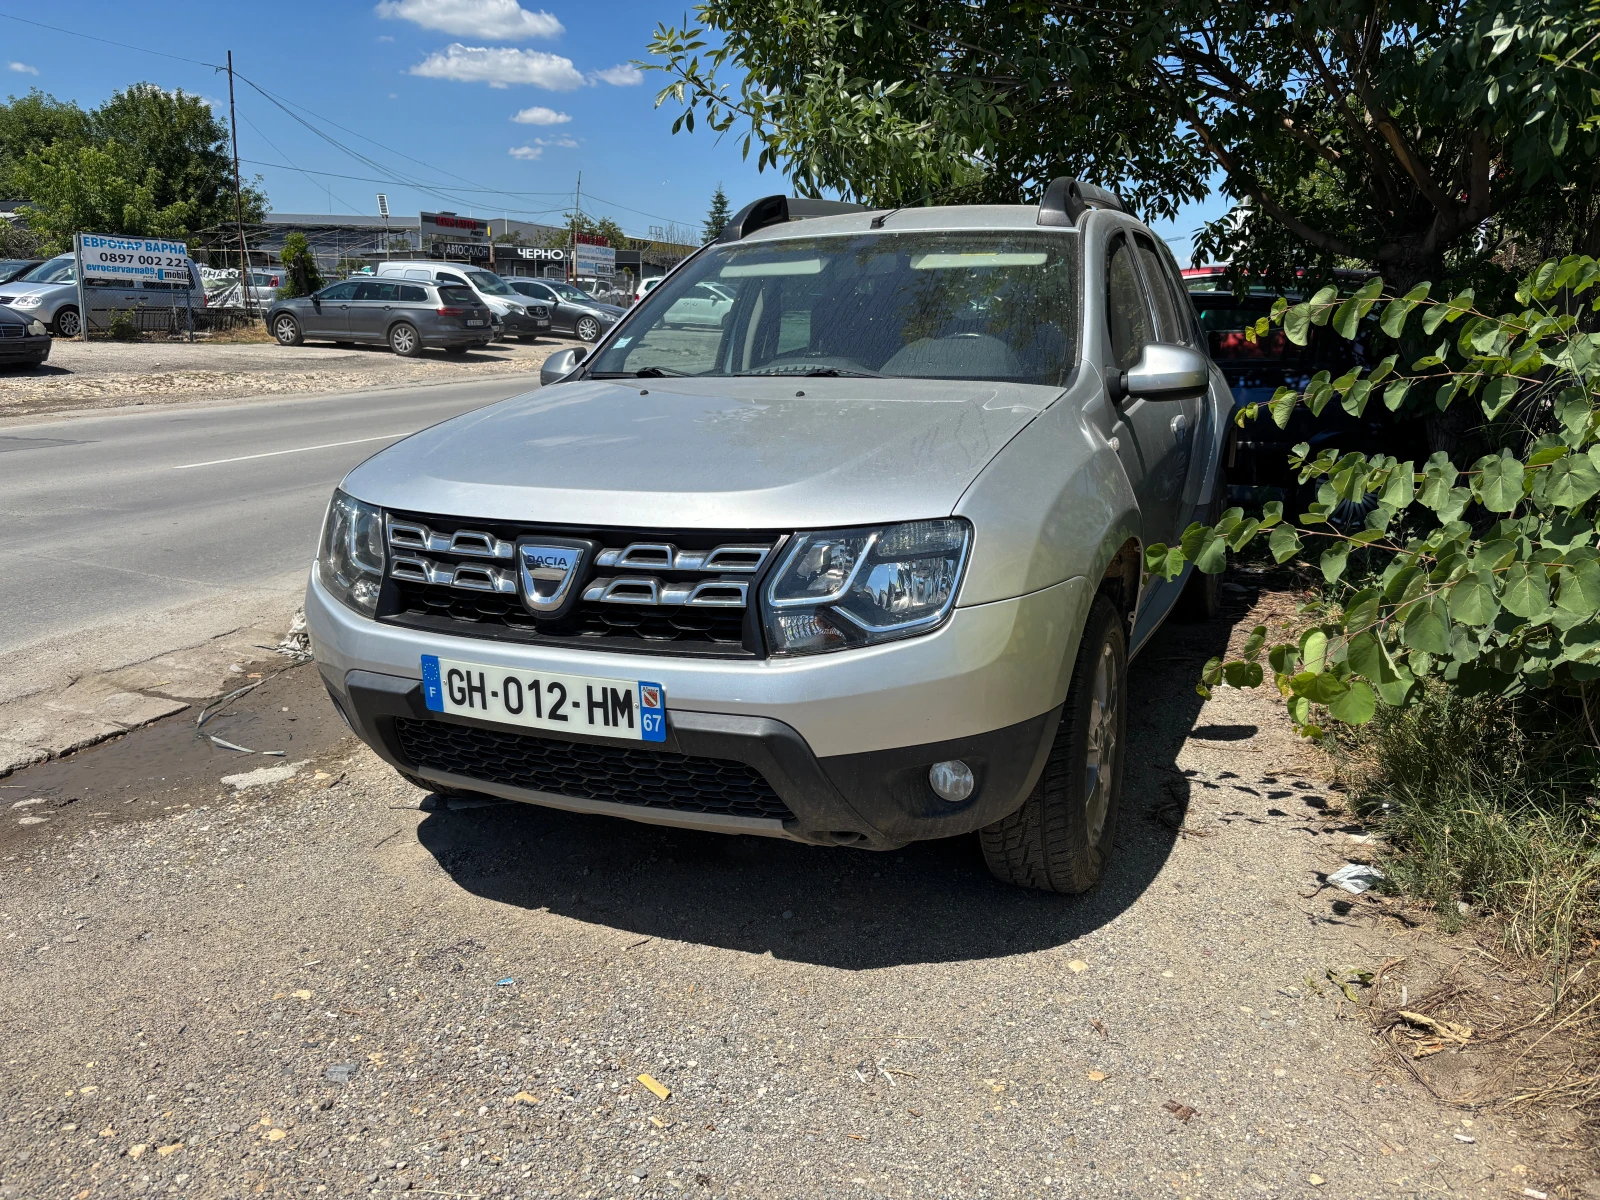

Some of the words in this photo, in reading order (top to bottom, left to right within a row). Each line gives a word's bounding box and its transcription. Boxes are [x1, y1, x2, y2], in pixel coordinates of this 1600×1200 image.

[83, 236, 143, 252] ЕВРОКАР
[145, 242, 187, 256] ВАРНА
[446, 244, 489, 257] АВТОСАЛОН
[517, 248, 564, 260] ЧЕРНО
[100, 252, 134, 264] 0897
[138, 255, 162, 267] 002
[166, 257, 189, 268] 225
[527, 554, 568, 567] DACIA
[429, 686, 437, 698] F
[447, 668, 635, 729] GH-012-HM
[643, 713, 662, 733] 67
